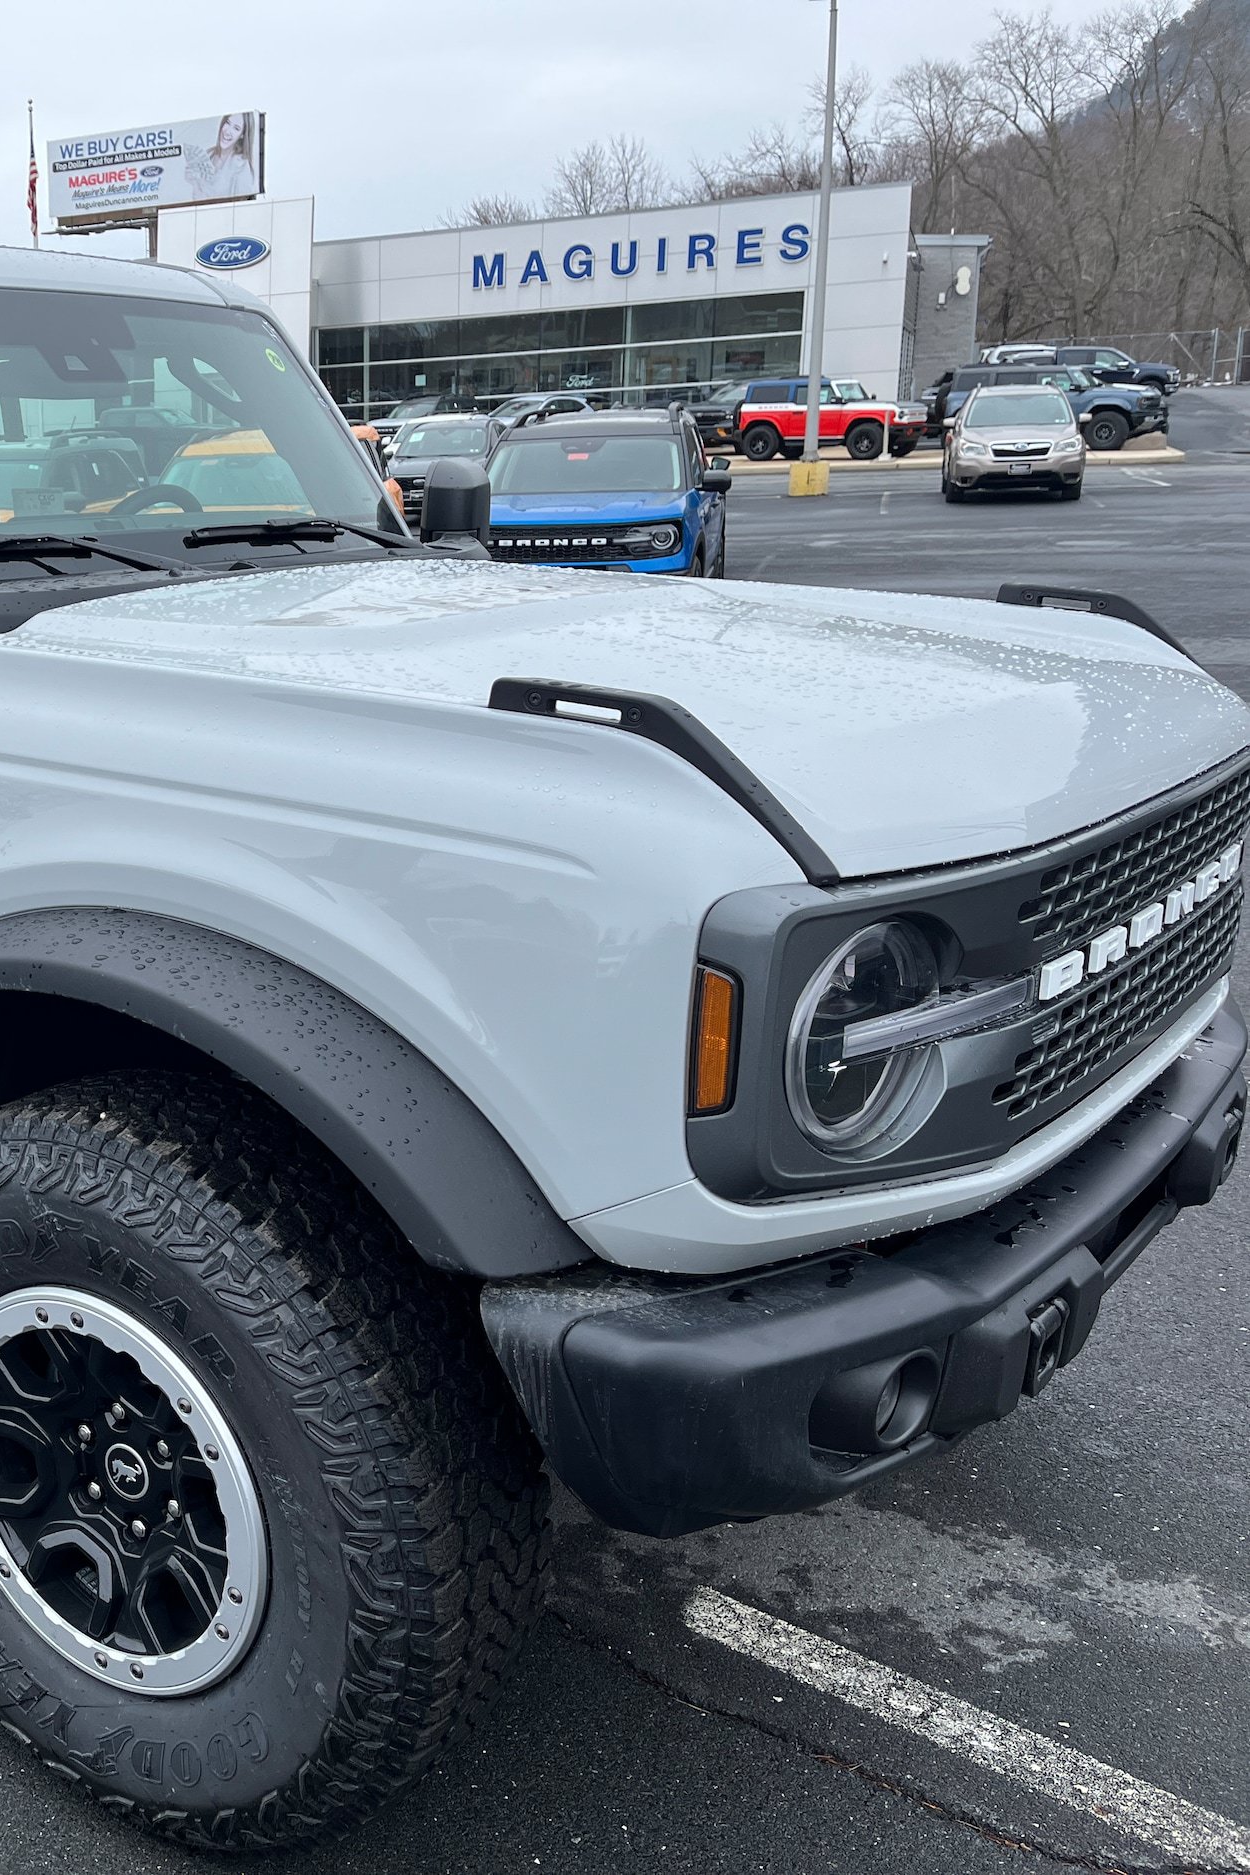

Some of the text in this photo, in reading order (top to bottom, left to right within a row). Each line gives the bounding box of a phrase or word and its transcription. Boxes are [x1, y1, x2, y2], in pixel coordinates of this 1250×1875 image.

[59, 129, 173, 159] WE BUY CARS!
[54, 146, 181, 171] Top Dollar Paid for All Makes & Models
[68, 167, 138, 189] MAGUIRE'S
[129, 177, 162, 194] More!
[74, 193, 159, 210] MaguiresDuncannon.com
[209, 241, 252, 263] Ford
[471, 223, 812, 290] MAGUIRES
[565, 374, 595, 388] Ford
[498, 537, 607, 547] BRONCO
[1038, 843, 1242, 1001] BRONCO
